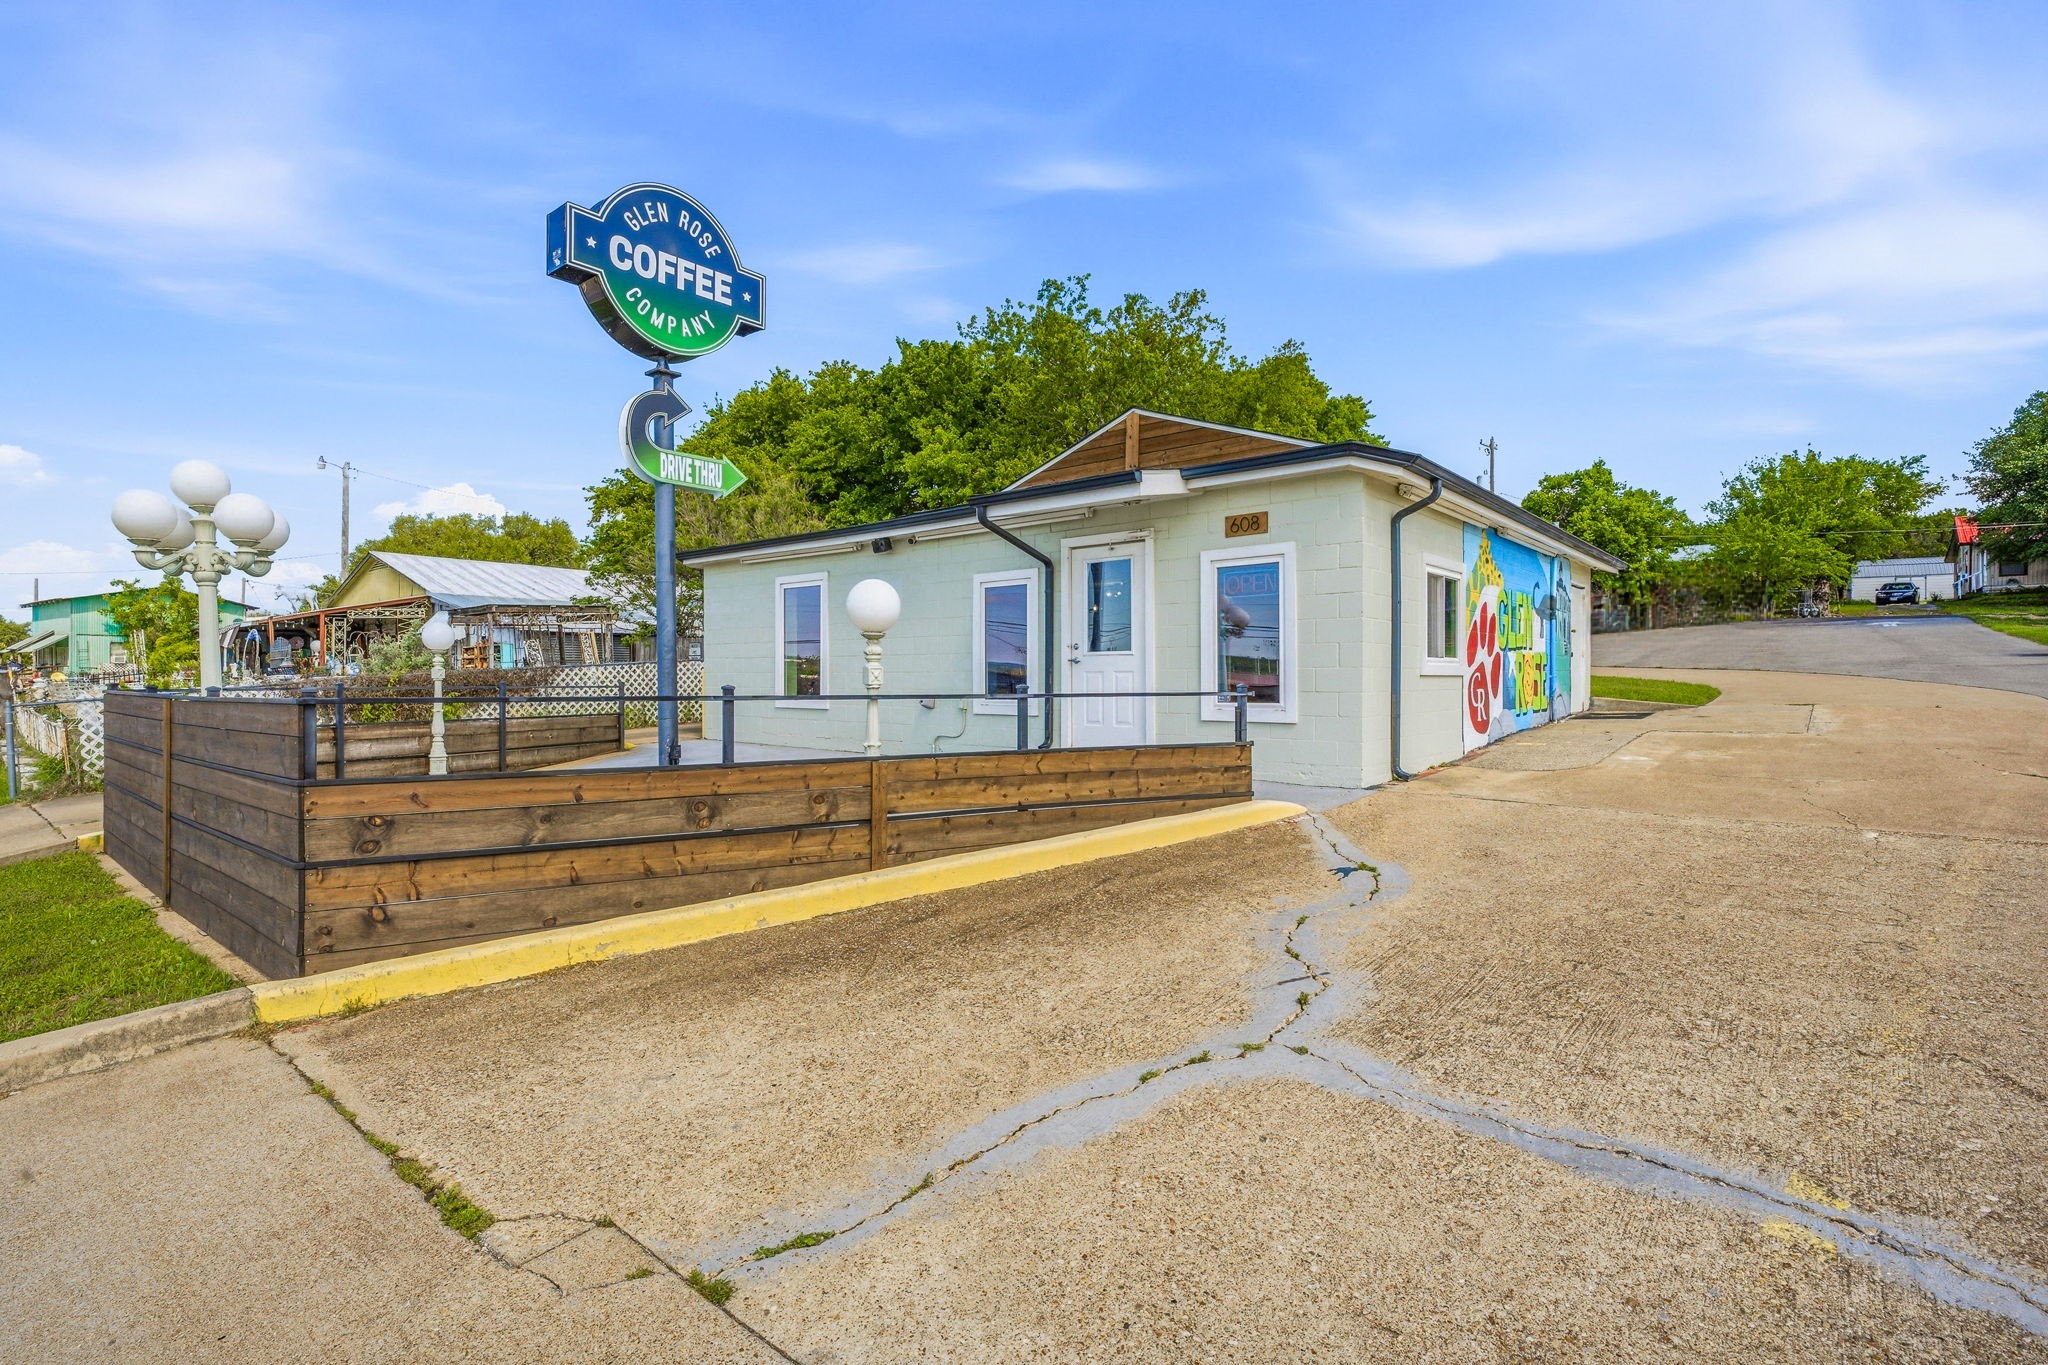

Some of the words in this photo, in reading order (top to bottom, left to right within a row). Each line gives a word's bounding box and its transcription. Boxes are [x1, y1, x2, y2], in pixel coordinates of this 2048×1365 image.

[624, 202, 669, 231] GLEN
[679, 210, 721, 259] ROSE
[609, 235, 733, 307] COFFEE
[626, 287, 715, 337] COMPANY
[660, 453, 693, 483] DRIVE
[694, 459, 723, 488] THRU
[1230, 515, 1260, 534] 608
[1226, 573, 1277, 594] OPEN
[1497, 589, 1533, 651] GLEN
[1516, 651, 1548, 717] ROSE
